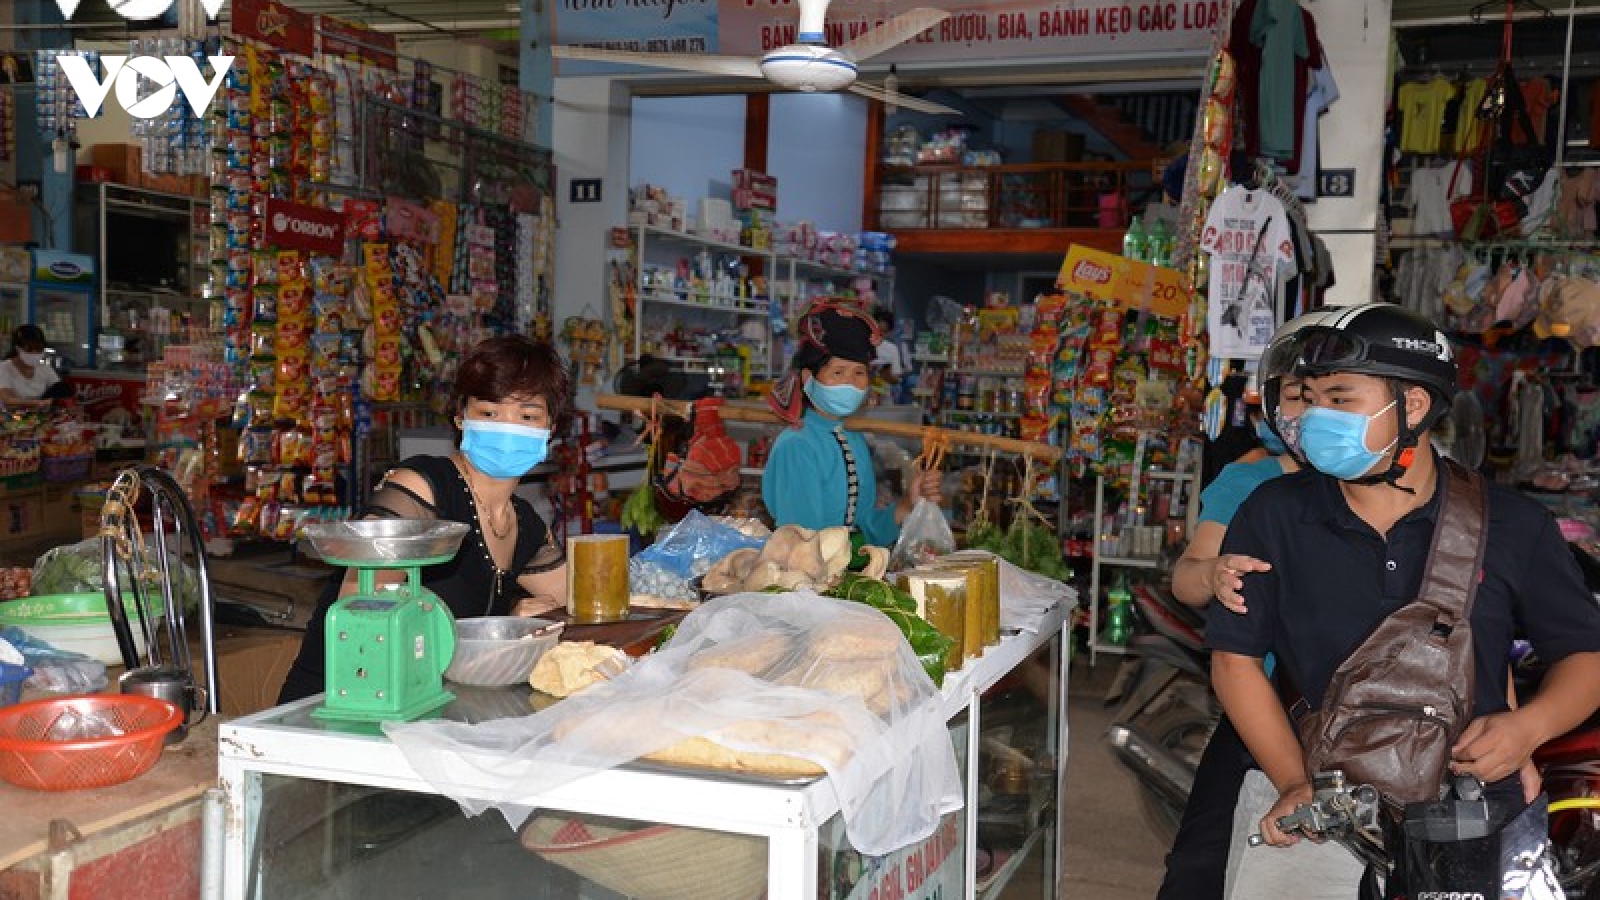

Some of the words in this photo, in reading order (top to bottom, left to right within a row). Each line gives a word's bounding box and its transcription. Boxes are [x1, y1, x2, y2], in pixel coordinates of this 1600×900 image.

[998, 12, 1033, 42] BIA,
[1039, 3, 1089, 38] BÁNH
[1096, 7, 1133, 40] KẸO
[1139, 1, 1177, 32] CÁC
